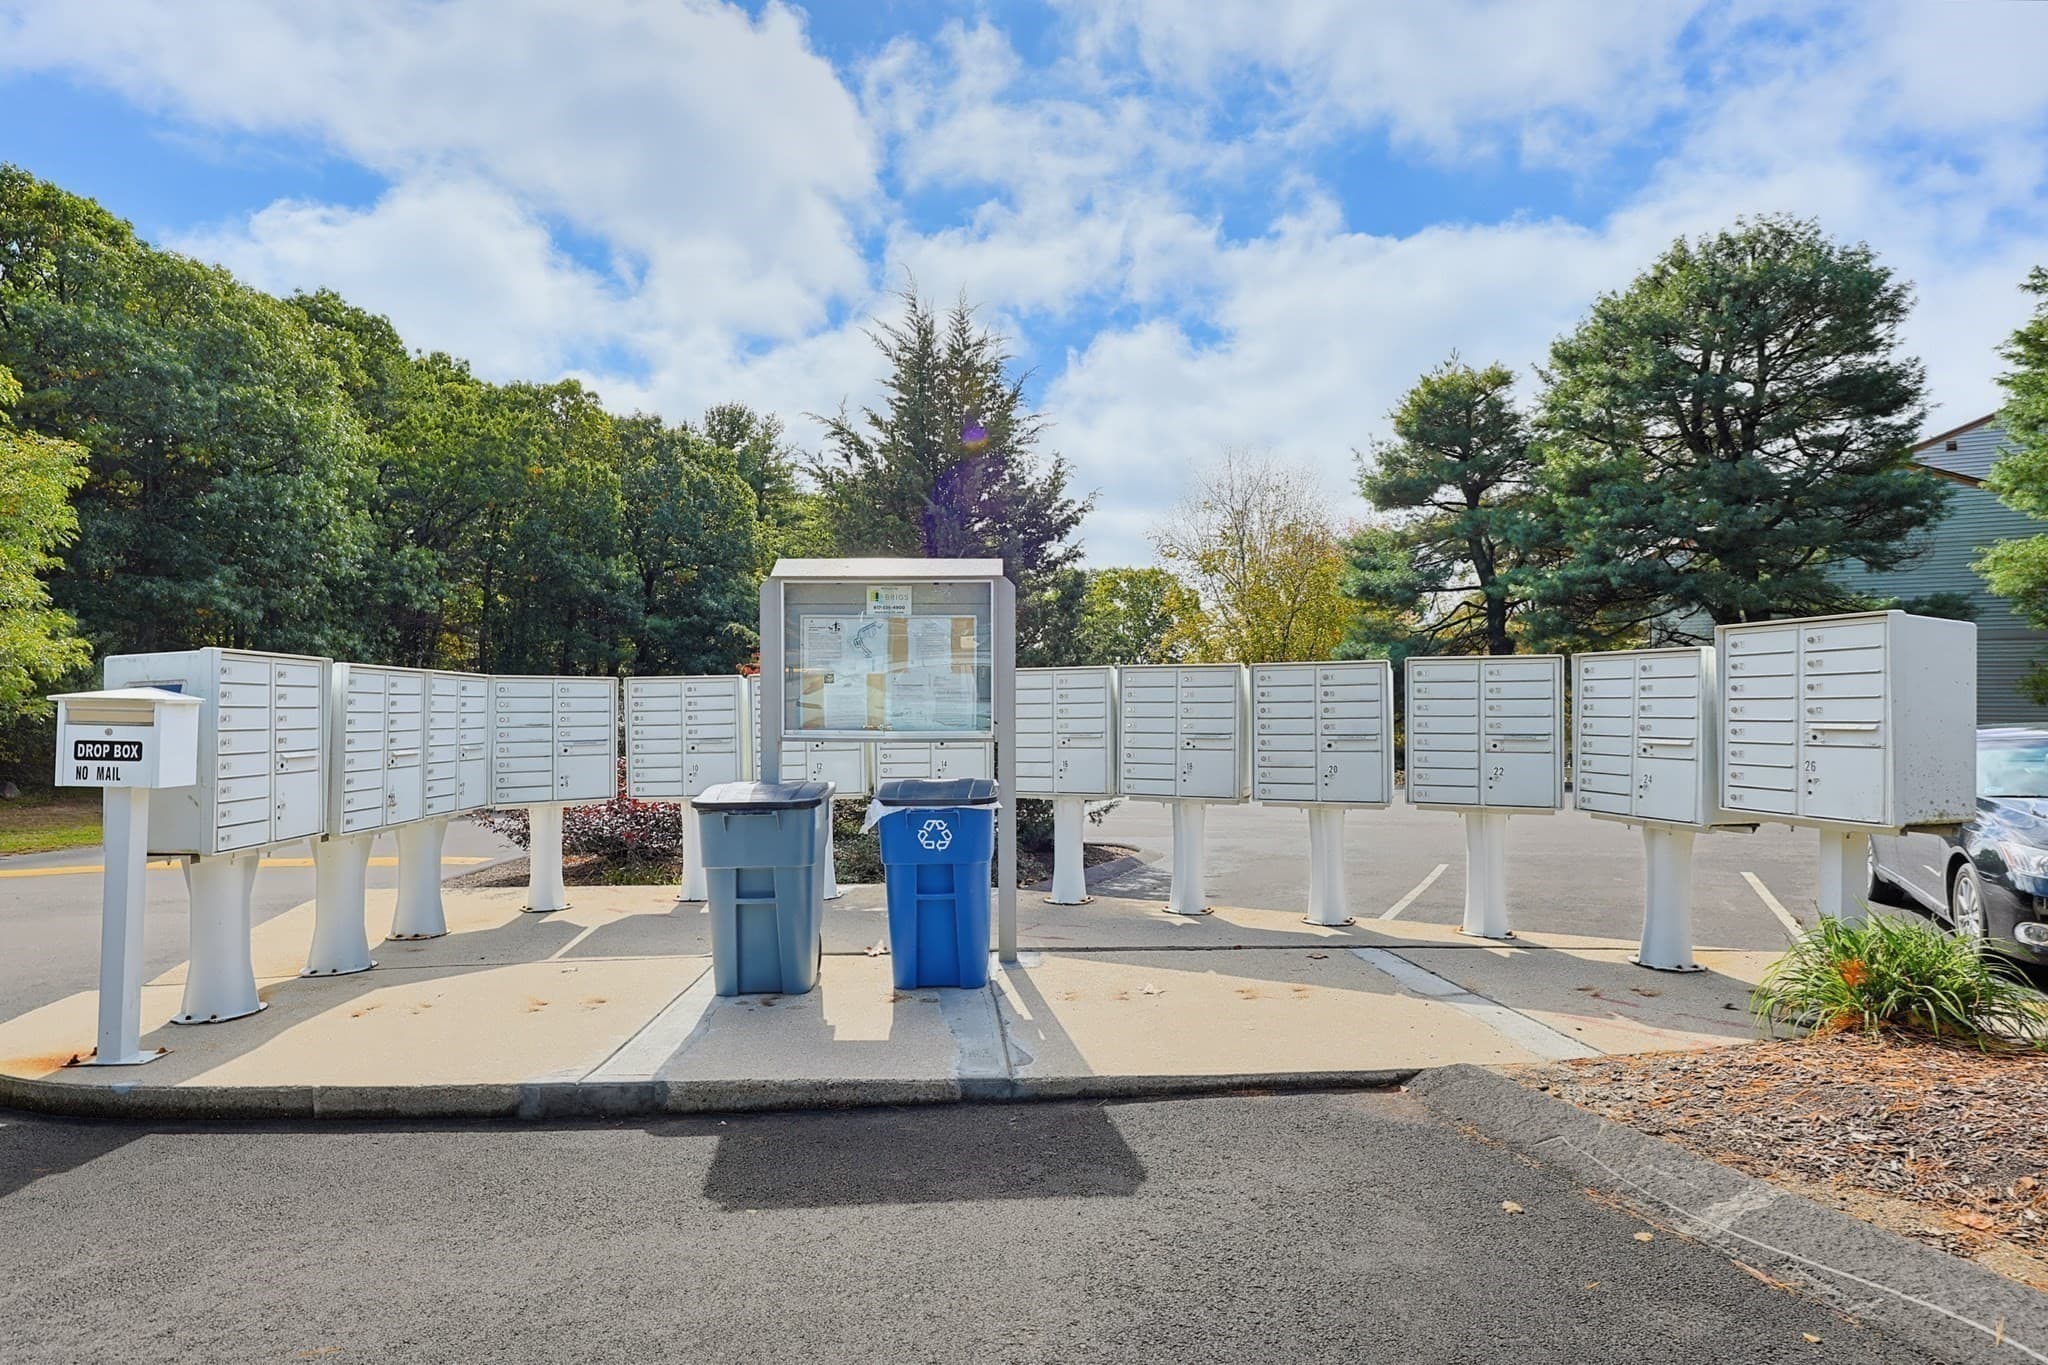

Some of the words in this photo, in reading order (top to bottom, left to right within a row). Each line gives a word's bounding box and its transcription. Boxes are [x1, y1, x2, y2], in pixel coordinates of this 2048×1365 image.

[77, 743, 110, 758] DROP
[113, 744, 139, 759] BOX
[1328, 765, 1338, 774] 20
[1493, 766, 1504, 776] 22
[1804, 760, 1817, 772] 26
[75, 765, 89, 780] NO
[96, 766, 121, 781] MAIL
[1643, 774, 1652, 784] 24
